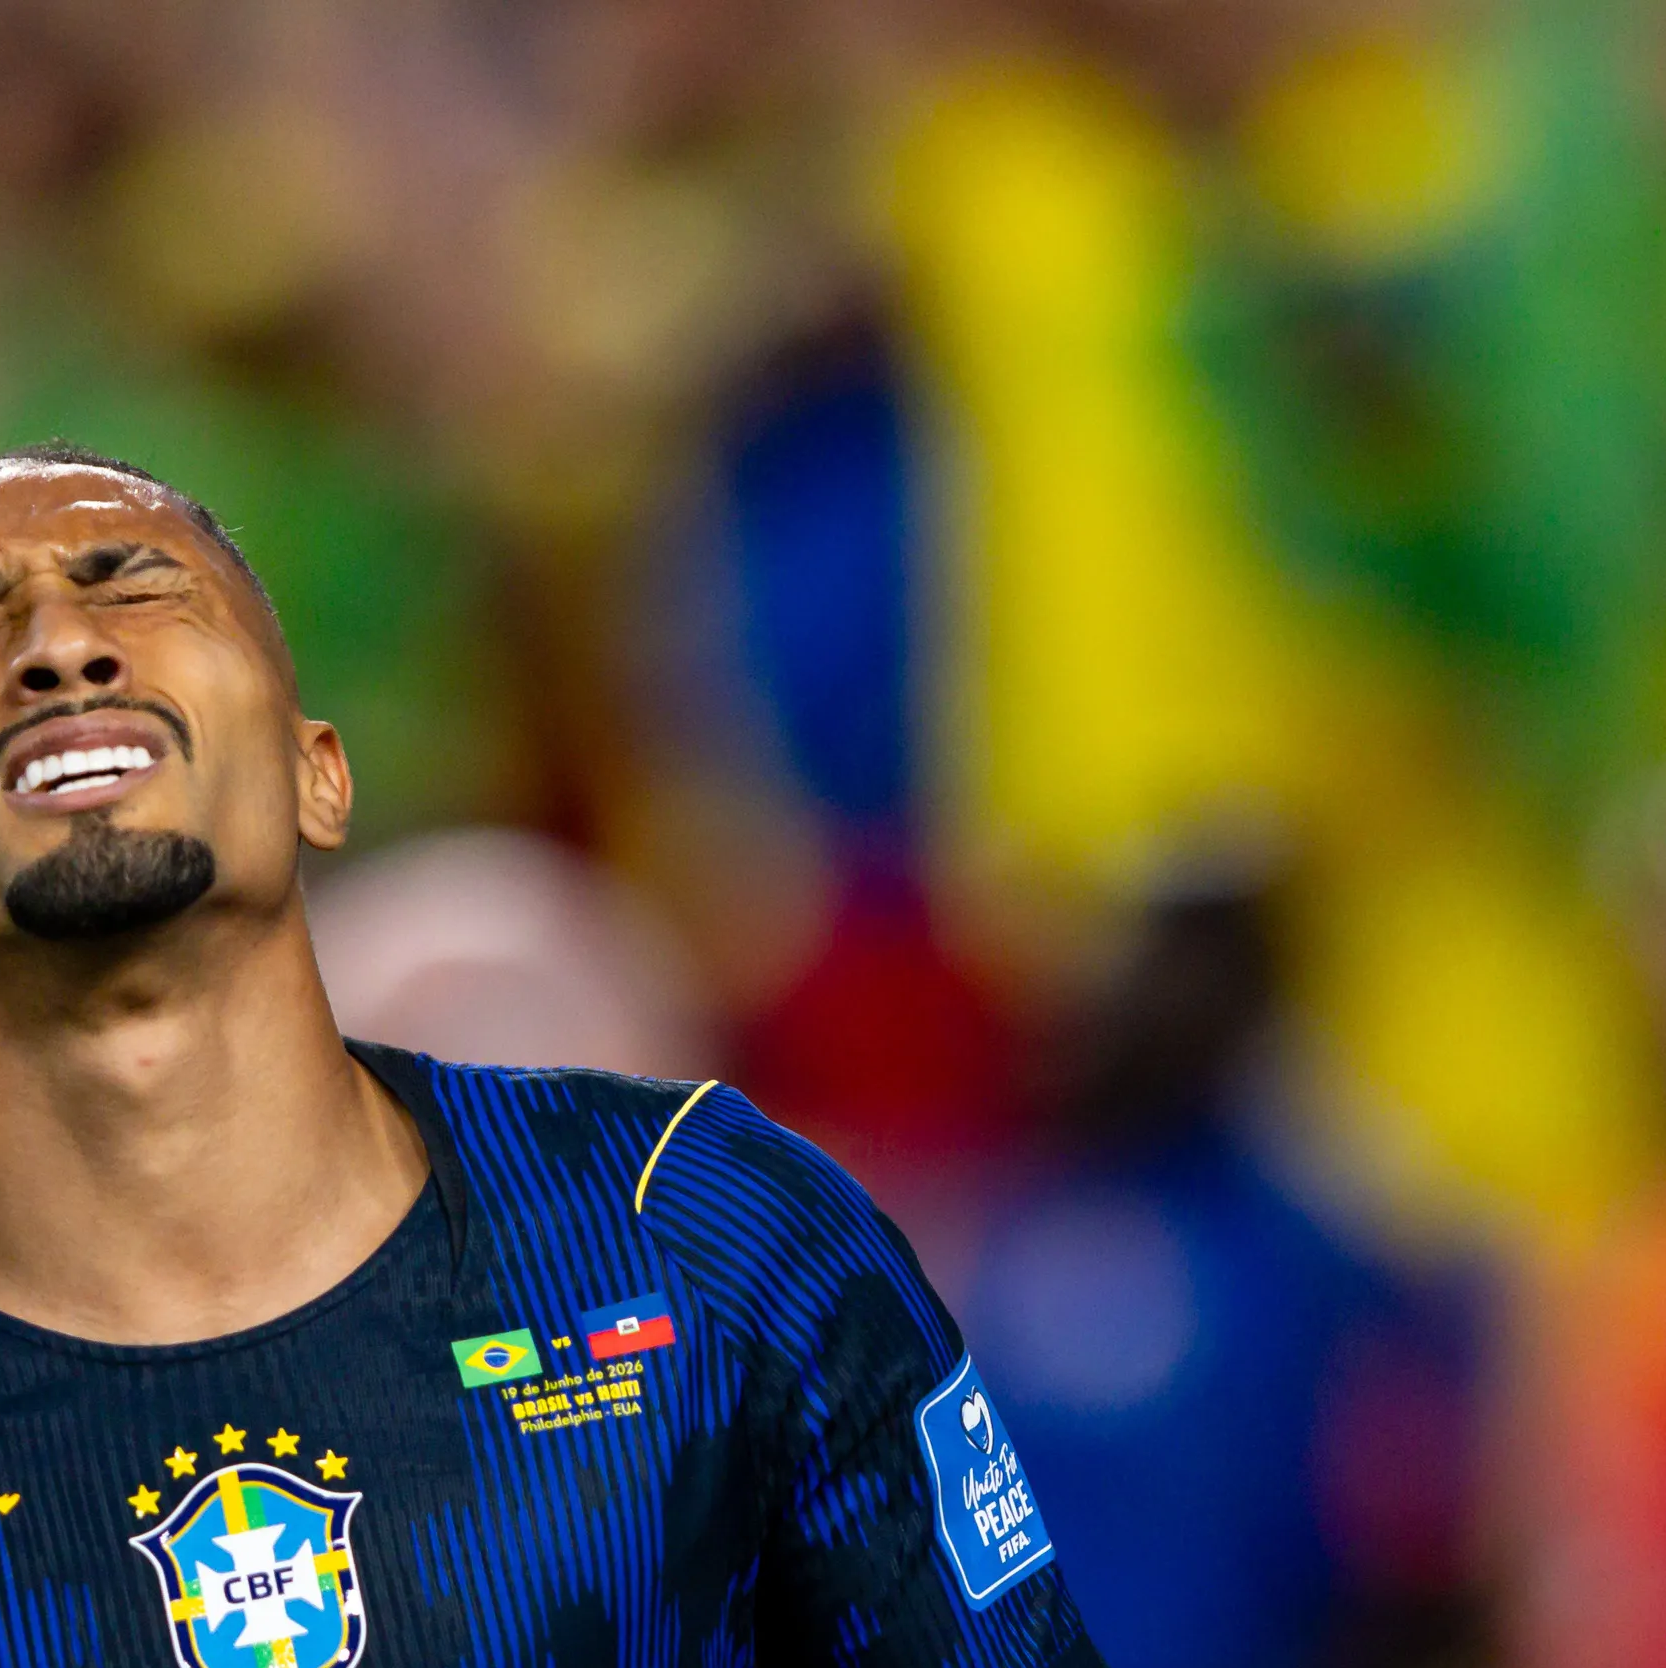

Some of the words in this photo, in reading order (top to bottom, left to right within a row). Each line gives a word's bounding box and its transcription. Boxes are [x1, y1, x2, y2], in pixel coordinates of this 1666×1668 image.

[551, 1336, 571, 1349] vs
[501, 1386, 517, 1400] 19
[522, 1383, 540, 1396] de
[544, 1373, 583, 1391] Junho
[586, 1367, 604, 1382] de
[607, 1359, 643, 1378] 2026
[513, 1393, 572, 1419] BRASIL
[574, 1392, 594, 1406] vs
[520, 1408, 603, 1435] Philadelphia
[612, 1401, 642, 1417] EUA
[963, 1460, 1003, 1510] Unite
[999, 1443, 1017, 1484] For
[974, 1479, 1033, 1547] PEACE
[998, 1530, 1030, 1563] FIFA
[222, 1564, 294, 1604] CBF
